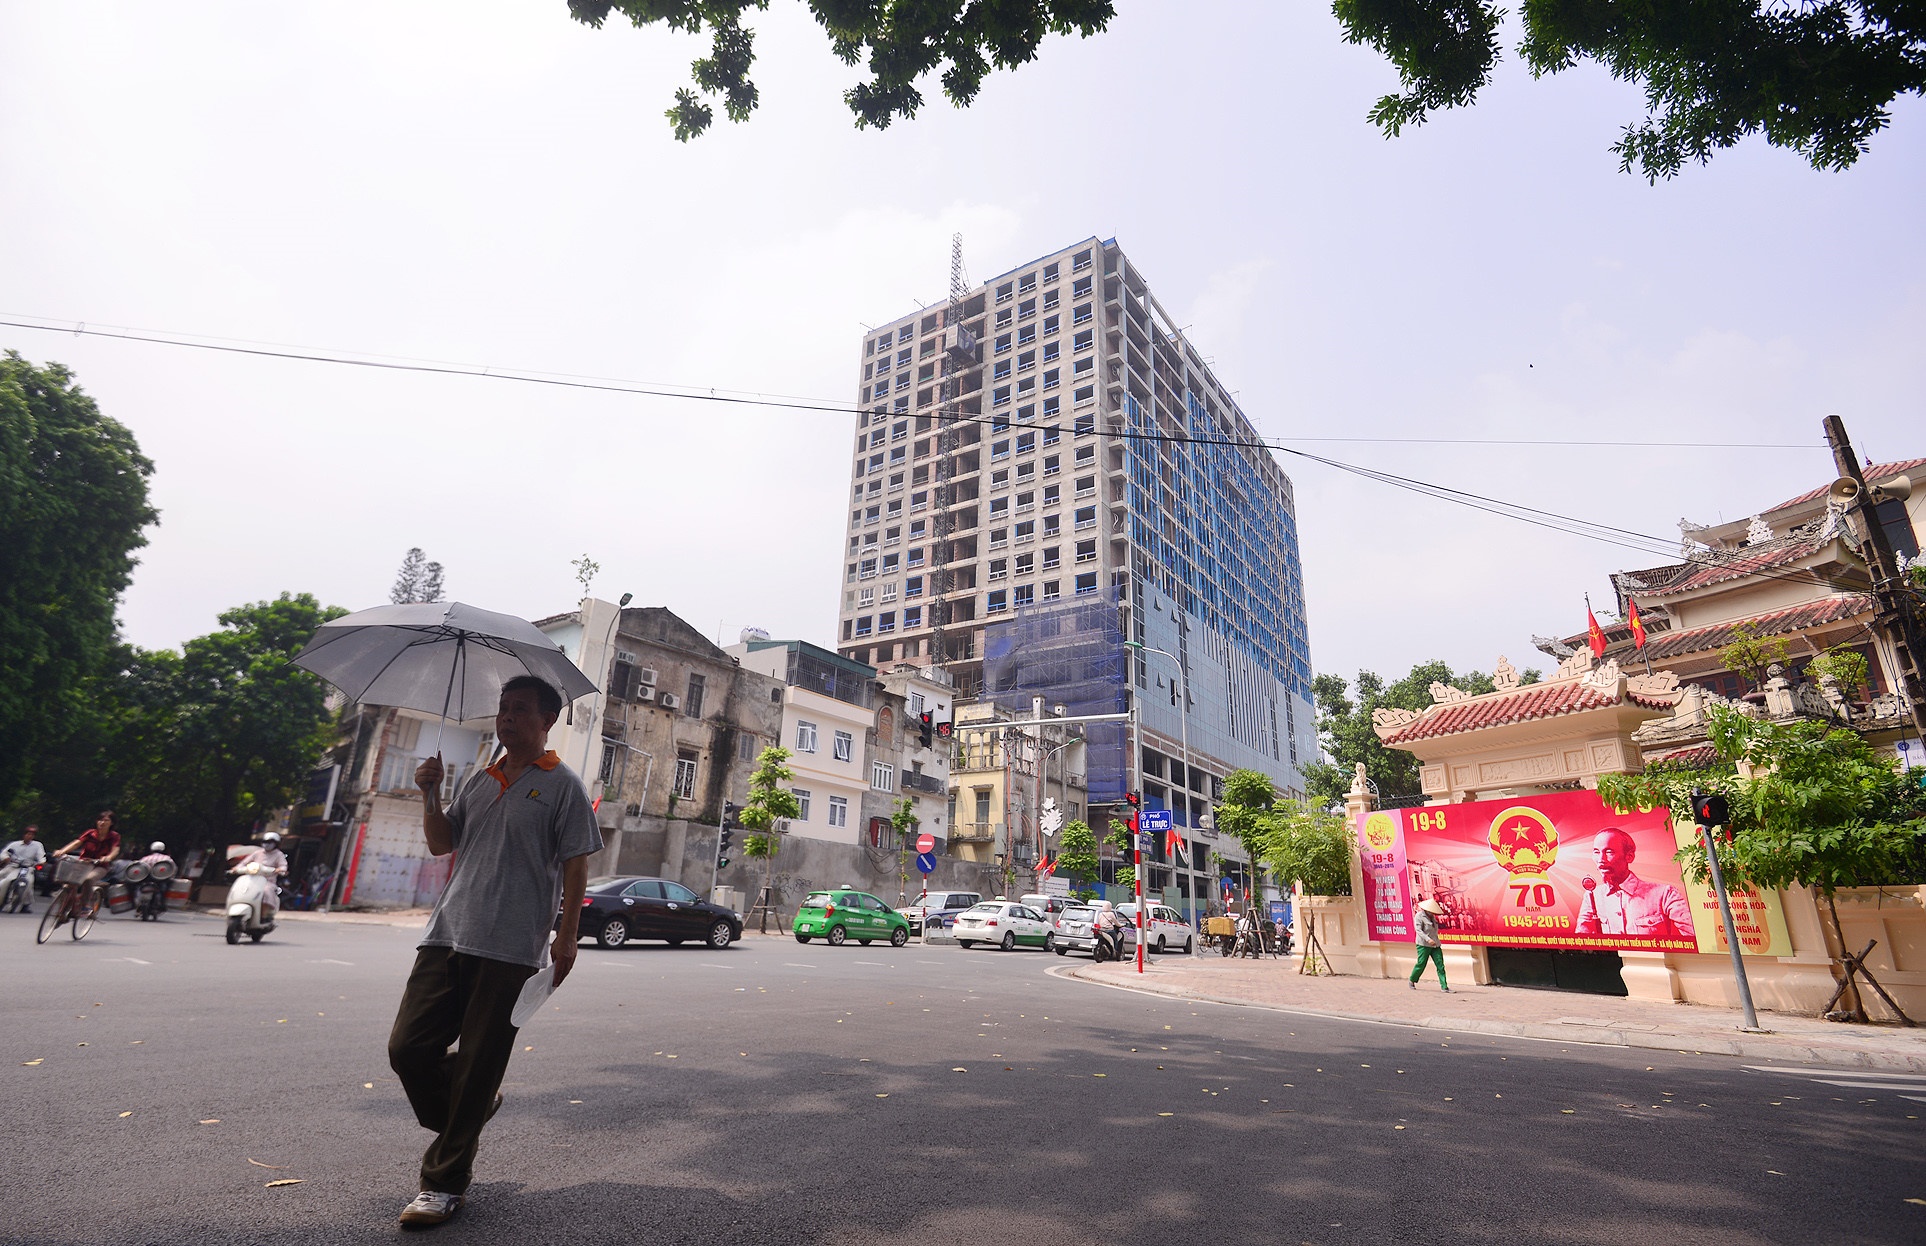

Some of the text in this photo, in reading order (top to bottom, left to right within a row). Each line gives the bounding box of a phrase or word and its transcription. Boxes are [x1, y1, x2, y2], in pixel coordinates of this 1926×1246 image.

[939, 724, 950, 736] 46
[1142, 820, 1168, 829] LÊ TRỰC
[1410, 811, 1446, 832] 19-8
[1372, 854, 1394, 863] 19-8
[1509, 884, 1555, 908] 70
[1503, 915, 1570, 928] 1945-2015
